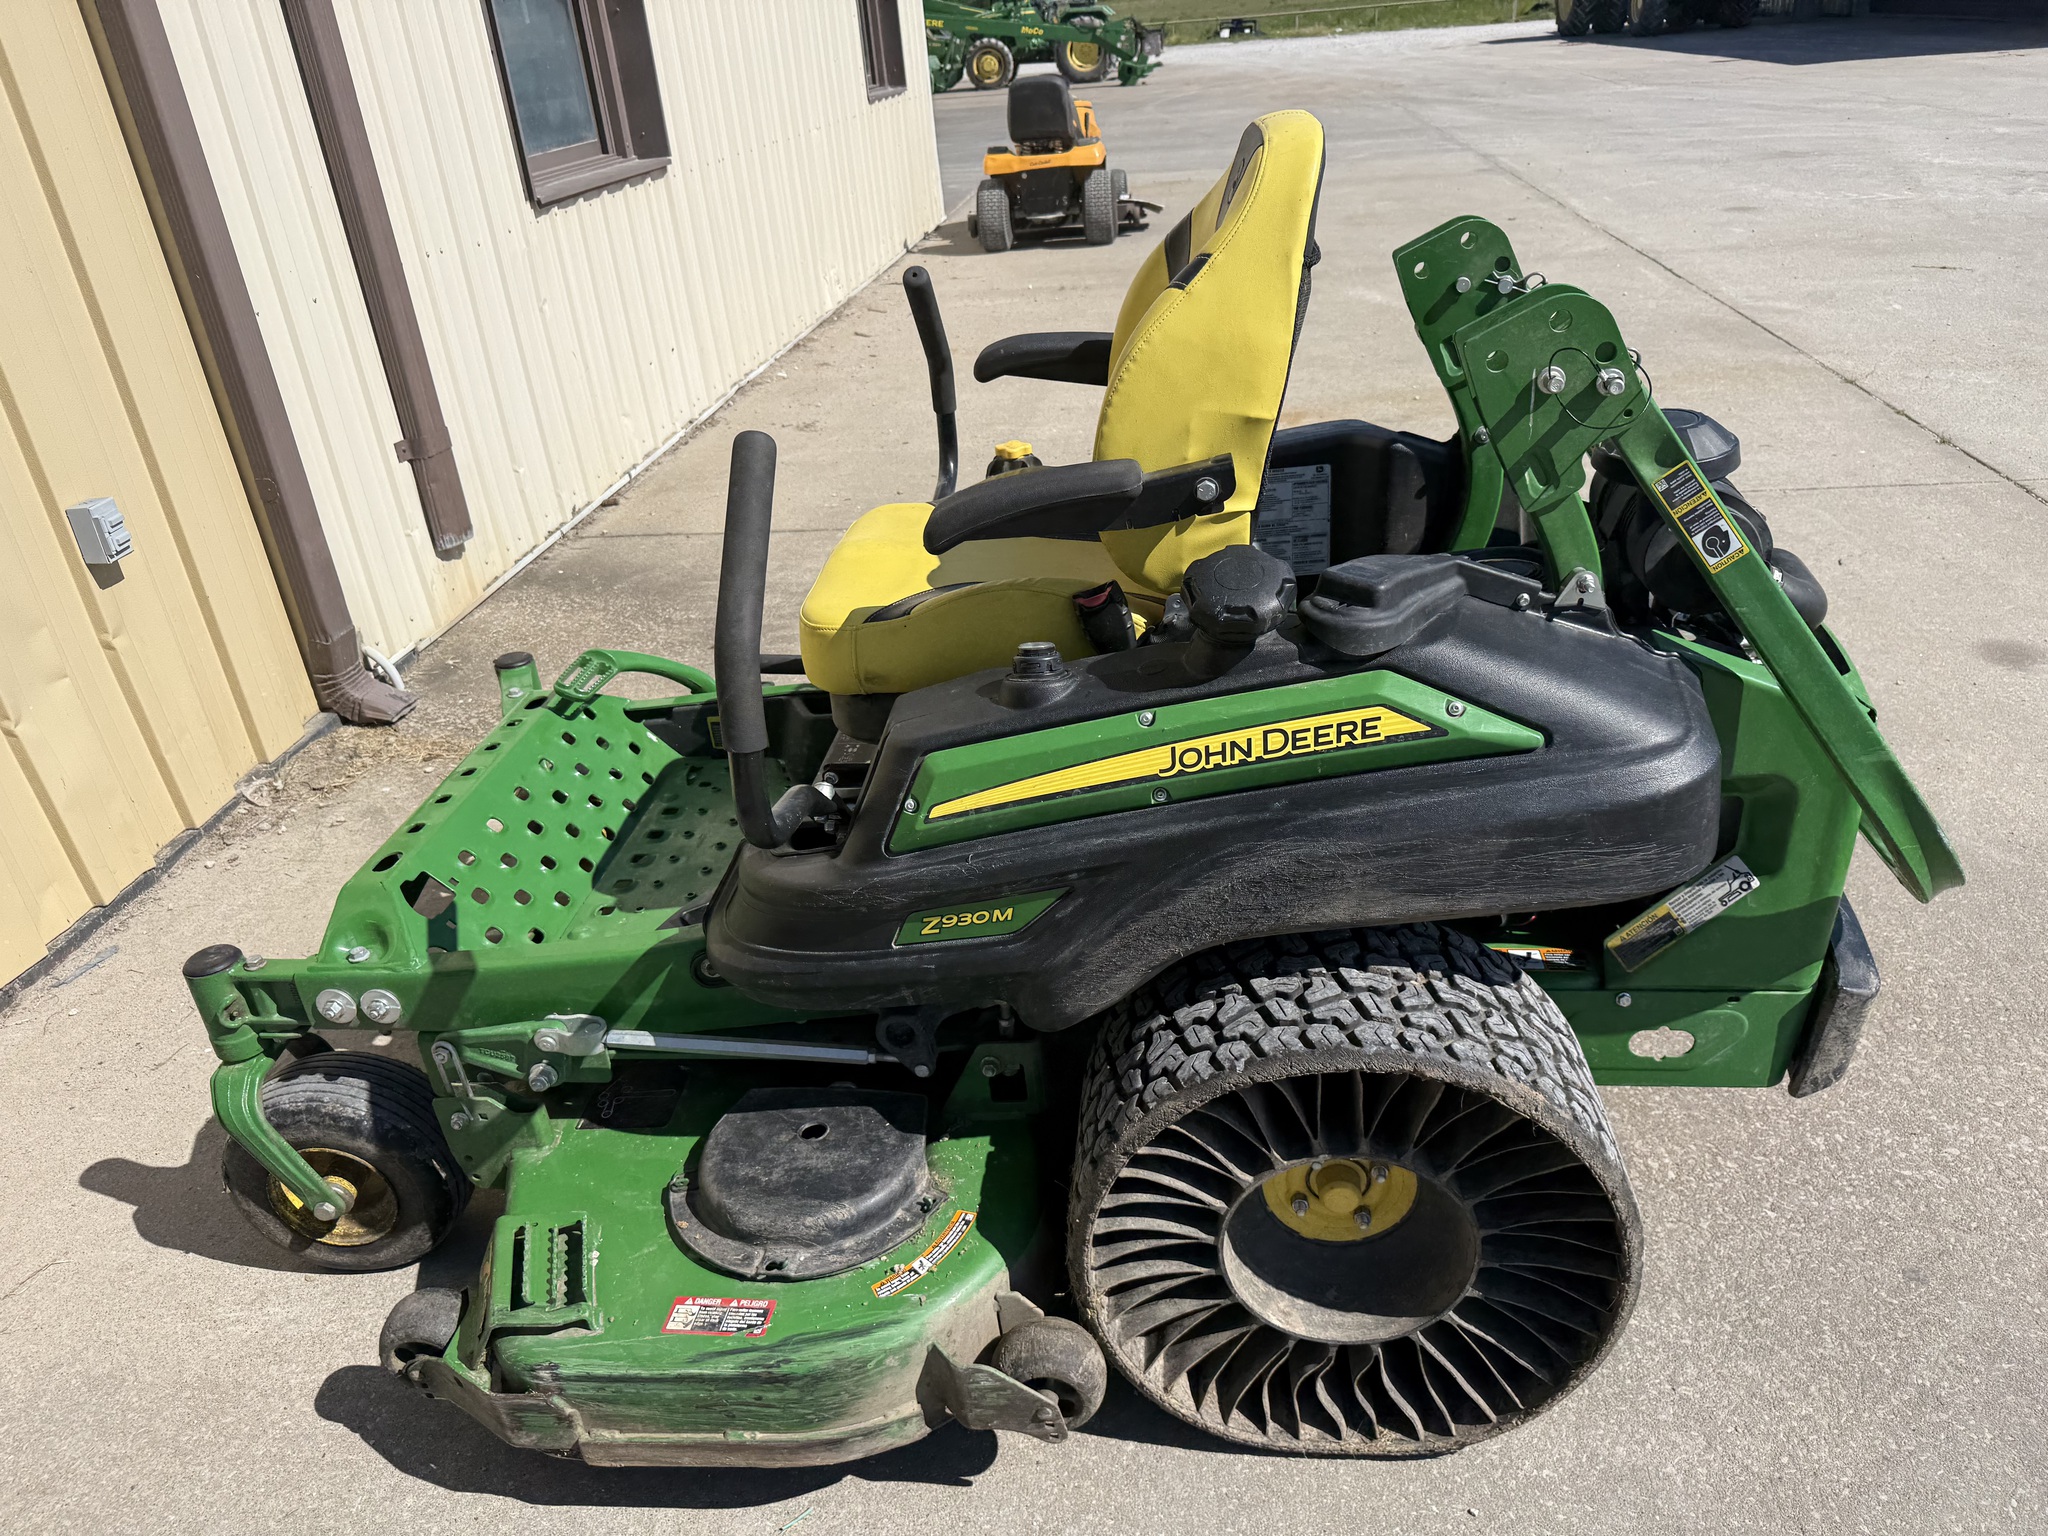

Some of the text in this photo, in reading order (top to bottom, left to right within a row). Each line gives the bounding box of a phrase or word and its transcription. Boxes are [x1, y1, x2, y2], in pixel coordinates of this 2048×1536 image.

[1021, 26, 1044, 35] MoCo
[1713, 552, 1740, 572] CAUTION
[1158, 716, 1382, 777] JOHN DEERE
[920, 906, 1014, 936] Z930M
[1626, 912, 1659, 939] ATENCIÓN
[694, 1297, 722, 1305] DANGER
